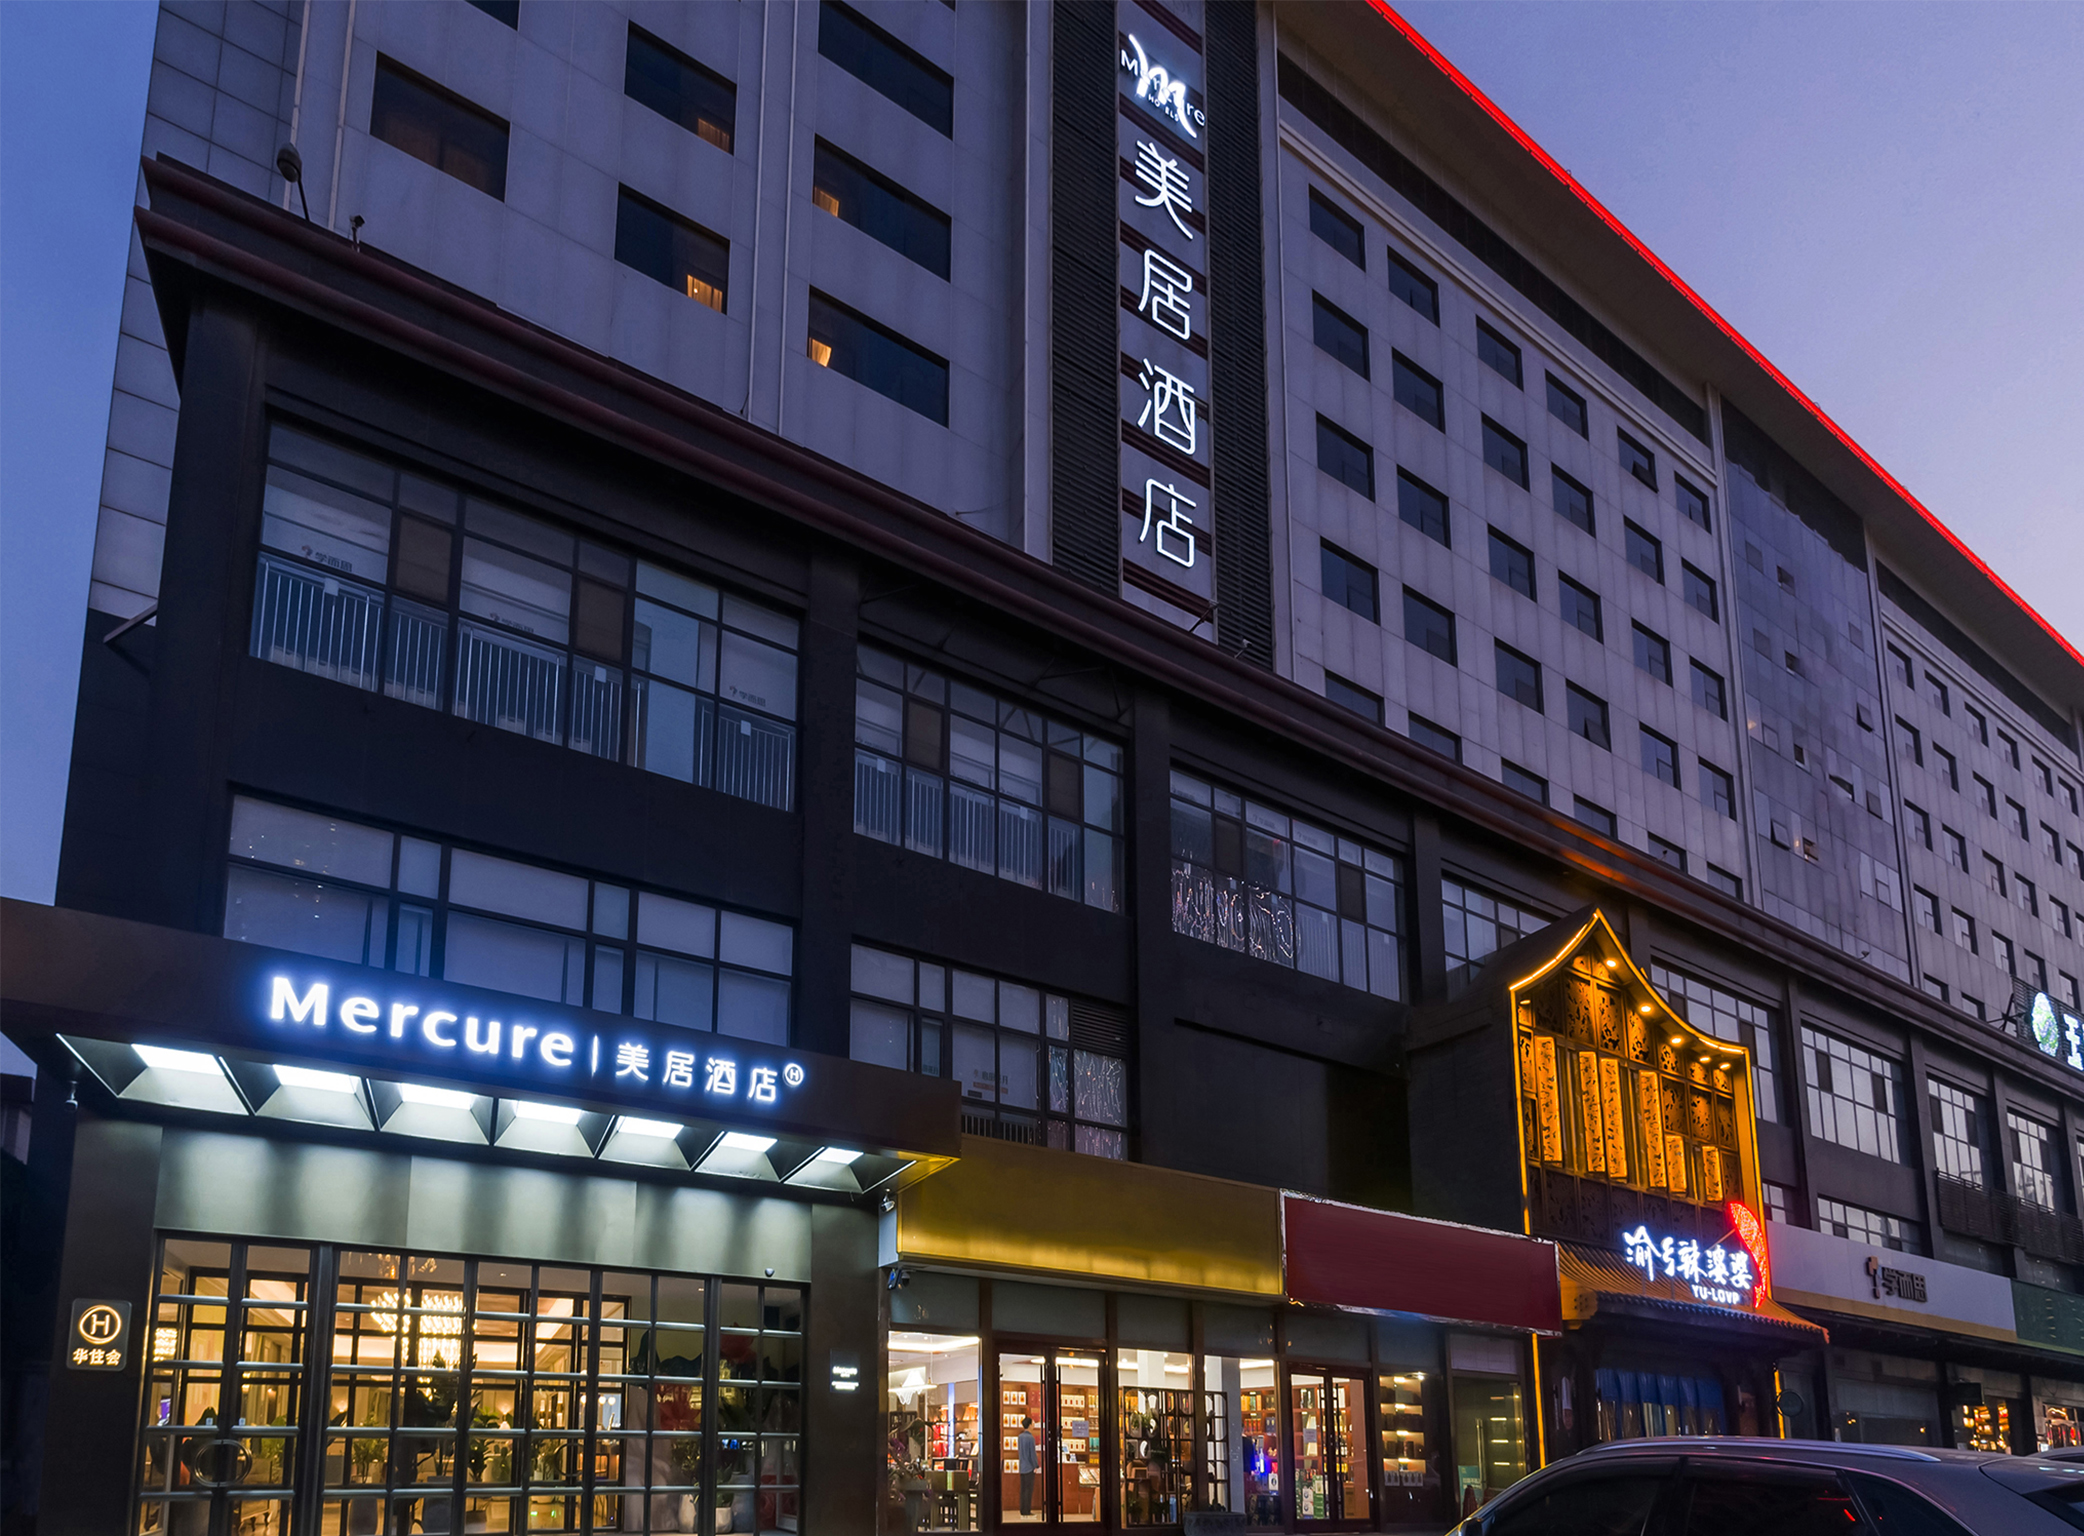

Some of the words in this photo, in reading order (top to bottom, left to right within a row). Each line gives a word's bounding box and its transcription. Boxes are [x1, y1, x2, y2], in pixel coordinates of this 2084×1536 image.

[1148, 93, 1179, 122] HOELS
[1134, 140, 1198, 568] 美居酒店
[268, 975, 575, 1069] Mercure
[614, 1041, 780, 1103] 美居酒店
[72, 1347, 122, 1367] 华住会
